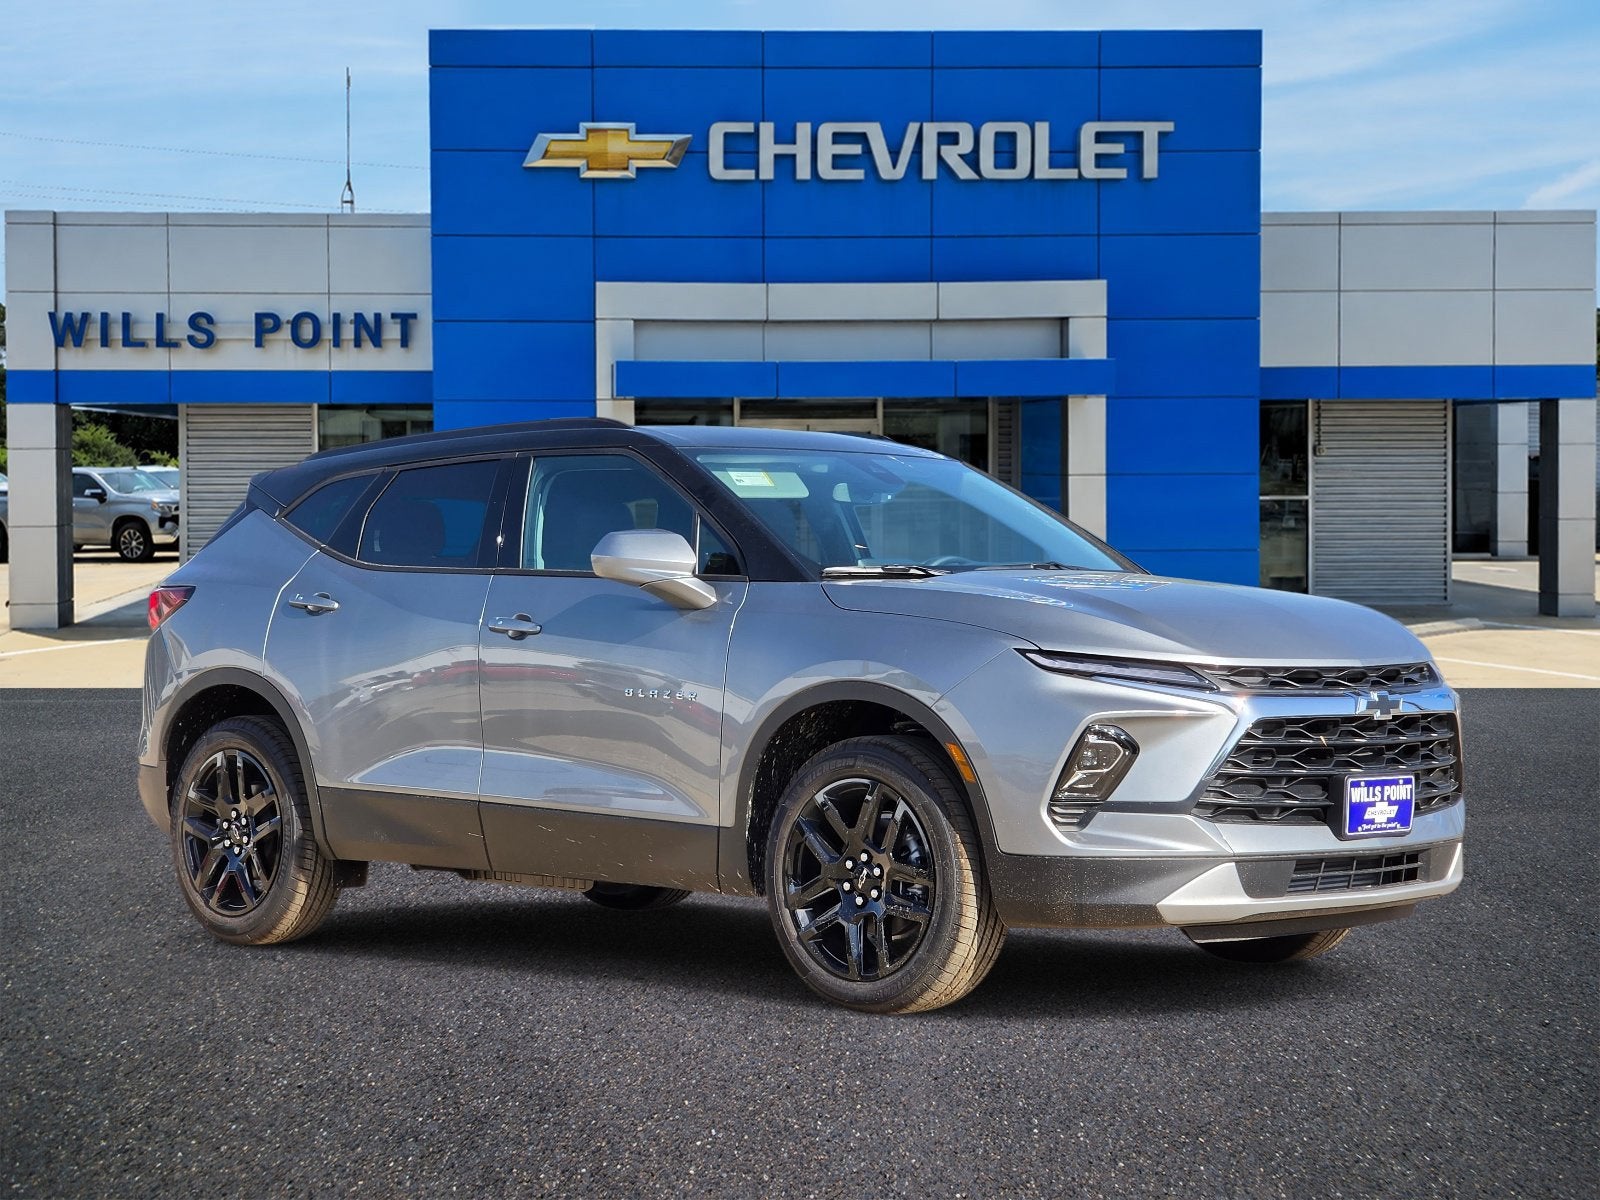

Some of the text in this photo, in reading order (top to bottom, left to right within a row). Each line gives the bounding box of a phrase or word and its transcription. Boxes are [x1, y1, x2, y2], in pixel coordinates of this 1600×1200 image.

[708, 121, 1175, 182] CHEVROLET
[48, 311, 418, 349] WILLS POINT
[624, 687, 697, 701] BLAZER
[1350, 784, 1412, 803] WILLS POINT
